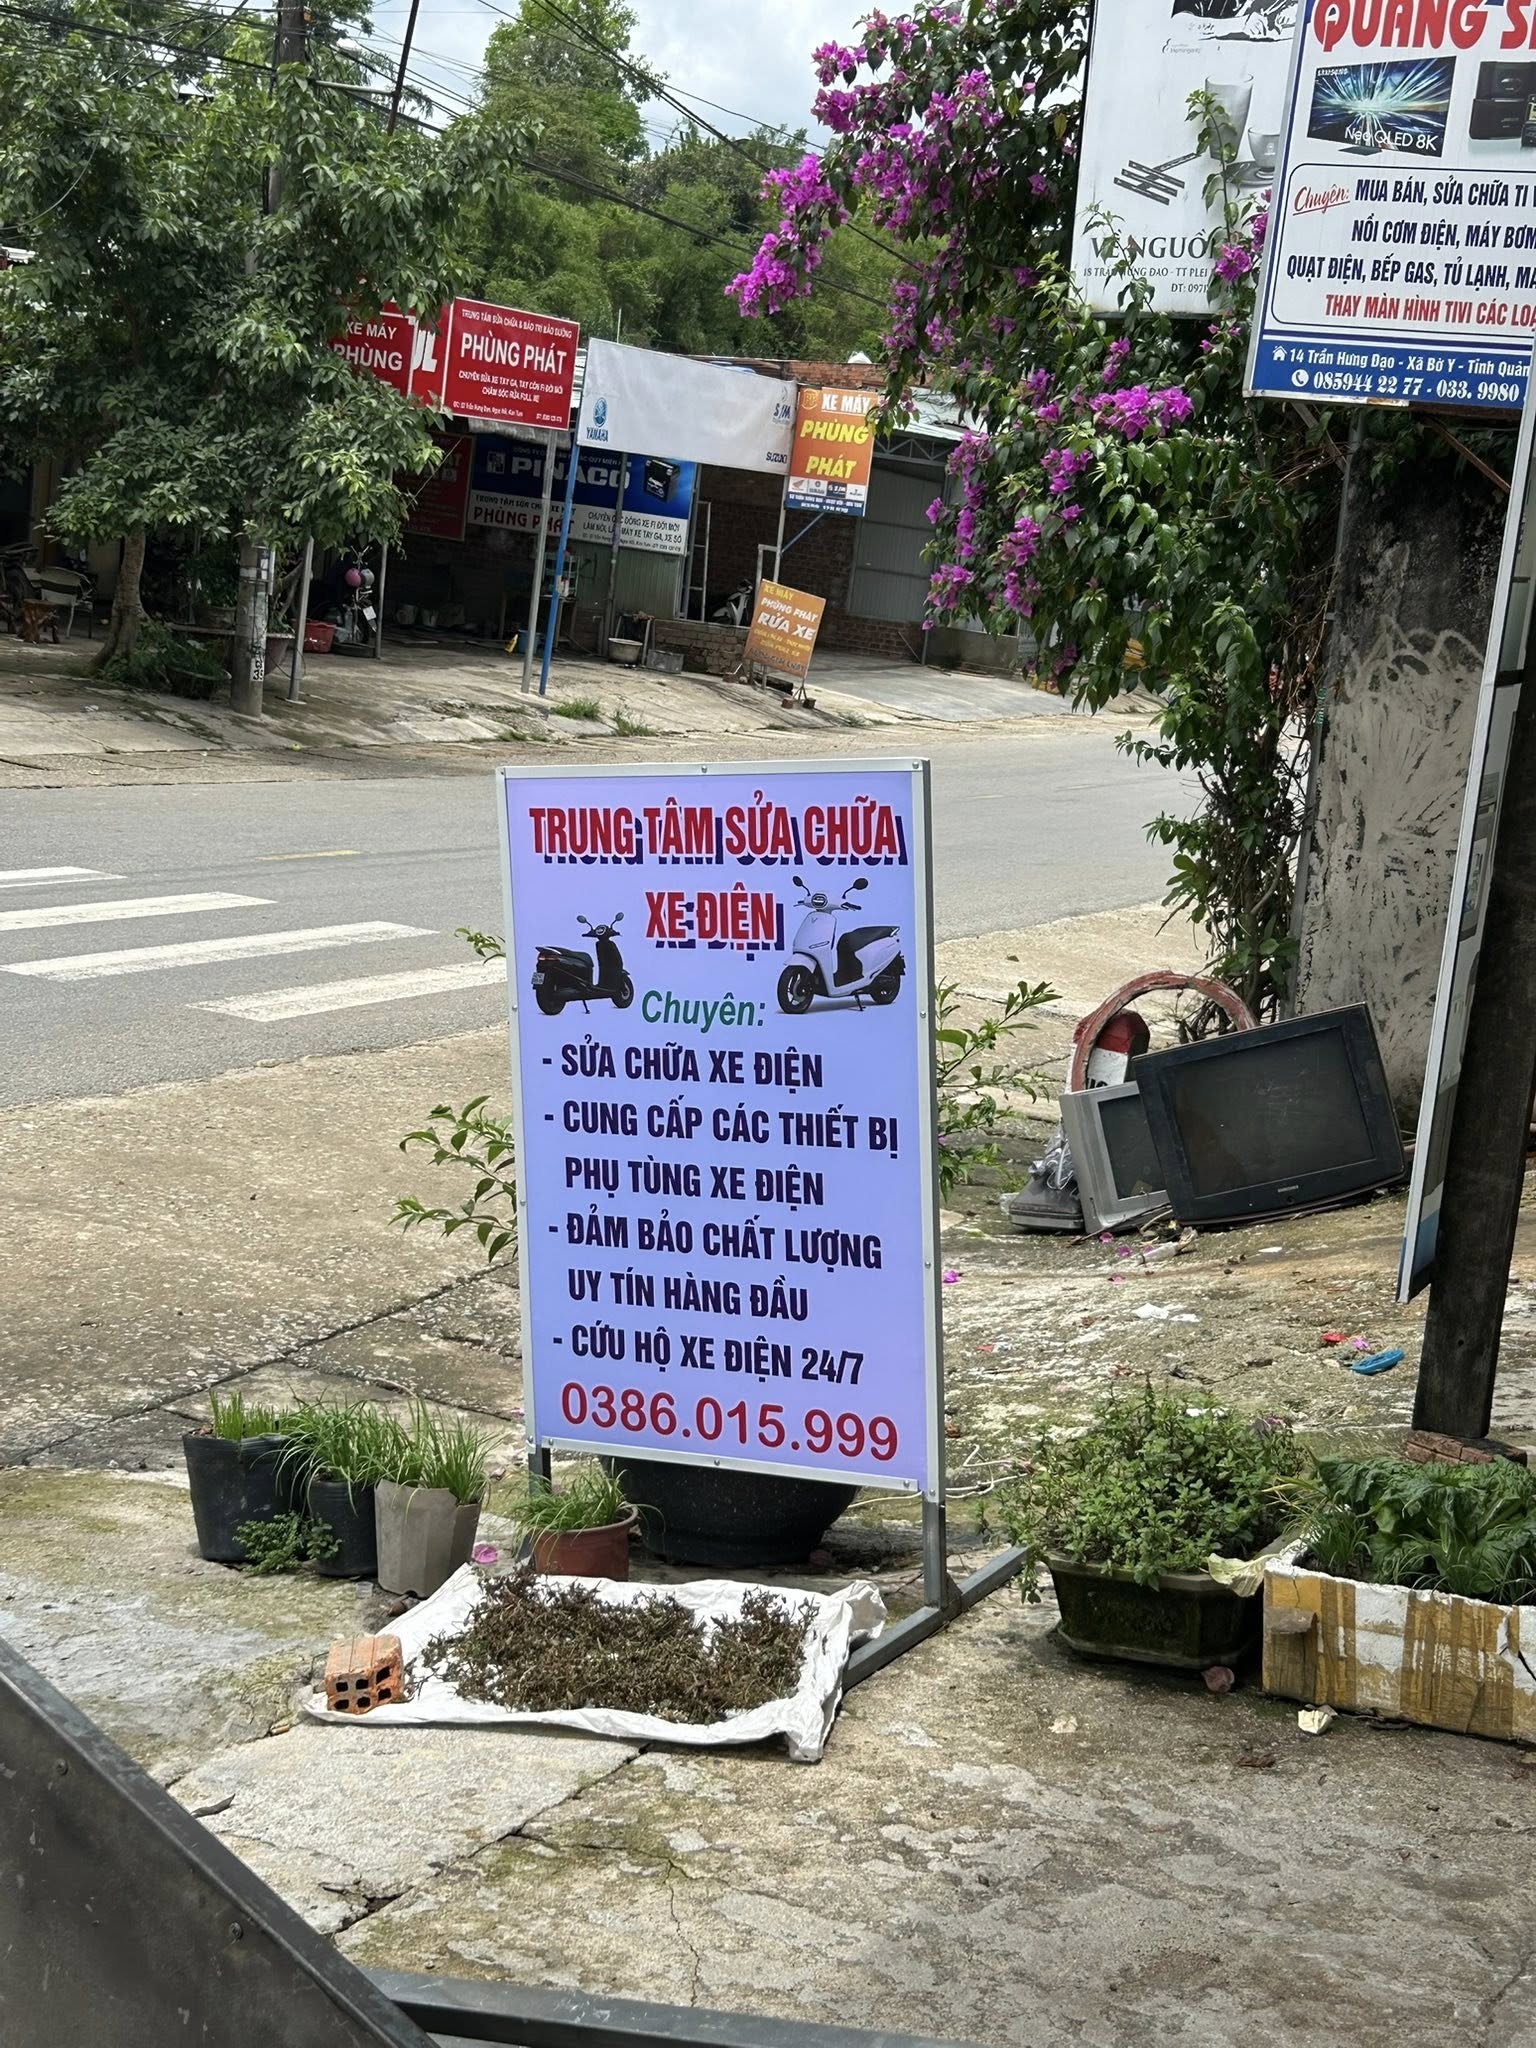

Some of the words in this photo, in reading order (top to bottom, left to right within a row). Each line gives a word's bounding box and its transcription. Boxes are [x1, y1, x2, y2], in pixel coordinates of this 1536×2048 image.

[1345, 127, 1372, 142] Neo
[1375, 130, 1414, 147] QLED
[1416, 134, 1439, 151] 8K
[1294, 184, 1349, 214] Chuyên:
[1355, 179, 1388, 202] MUA
[1392, 176, 1428, 206] BÁN,
[1433, 175, 1463, 204] SỬA
[1468, 180, 1508, 207] CHỮA
[1515, 185, 1529, 207] TI
[1127, 228, 1214, 259] NGUỒ
[1382, 220, 1418, 244] CƠM
[1420, 219, 1460, 250] ĐIỆN,
[1465, 220, 1501, 248] MÁY
[1503, 225, 1536, 250] BƠM
[1287, 255, 1325, 282] QUẠT
[1327, 254, 1366, 284] ĐIỆN,
[1371, 253, 1401, 282] BẾP
[1404, 261, 1438, 287] GAS,
[1444, 256, 1463, 286] TỦ
[1465, 263, 1509, 291] LẠNH,
[1325, 295, 1361, 317] THAY
[1363, 293, 1400, 319] MÀN
[1402, 295, 1439, 322] HÌNH
[1445, 301, 1473, 323] TIVI
[1476, 298, 1508, 326] CÁC
[347, 321, 362, 335] XE
[366, 323, 397, 340] MÁY
[333, 342, 403, 371] PHÙNG
[461, 330, 520, 367] PHÙNG
[523, 343, 567, 375] PHÁT
[1290, 349, 1304, 362] 14
[1337, 352, 1367, 369] Hưng
[1371, 356, 1395, 371] Đạo
[1406, 355, 1422, 371] Xã
[1427, 357, 1443, 372] Bờ
[1447, 359, 1456, 372] Y
[1468, 359, 1494, 375] Tỉnh
[1313, 372, 1372, 392] 085944
[1378, 375, 1398, 394] 22
[1402, 377, 1424, 396] 77
[1477, 381, 1519, 402] 9980
[822, 394, 838, 411] XE
[841, 394, 871, 414] MÁY
[800, 418, 869, 444] PHÙNG
[805, 454, 857, 479] PHÁT
[474, 506, 527, 527] PHÙNG
[758, 612, 790, 633] RỬA
[792, 623, 817, 640] XE
[529, 806, 636, 857] TRUNG
[643, 797, 714, 857] TÂM
[725, 790, 793, 857] SỬA
[804, 796, 898, 857] CHỮA
[646, 891, 687, 940] XE
[696, 882, 776, 951] ĐIỆN
[642, 990, 766, 1033] Chuyên:
[562, 1034, 616, 1078] SỬA
[625, 1042, 700, 1082] CHỮA
[709, 1051, 744, 1084] XE
[754, 1047, 822, 1093] ĐIỆN
[563, 1101, 637, 1136] CUNG
[647, 1095, 702, 1139] CẤP
[713, 1103, 769, 1143] CÁC
[779, 1104, 858, 1148] THIẾT
[869, 1117, 898, 1159] BỊ
[565, 1157, 619, 1198] PHỤ
[628, 1155, 700, 1197] TÙNG
[710, 1167, 745, 1200] XE
[755, 1163, 824, 1211] ĐIỆN
[567, 1204, 628, 1248] ĐẢM
[639, 1209, 693, 1254] BẢO
[703, 1215, 775, 1260] CHẤT
[785, 1230, 882, 1273] LƯỢNG
[568, 1269, 601, 1301] UY
[611, 1267, 654, 1307] TÍN
[664, 1273, 740, 1315] HÀNG
[750, 1275, 808, 1321] ĐẦU
[572, 1320, 625, 1360] CỨU
[635, 1326, 671, 1372] HỘ
[680, 1335, 715, 1370] XE
[724, 1336, 791, 1382] ĐIỆN
[802, 1347, 864, 1385] 24/7
[561, 1382, 898, 1461] 0386.015.999
